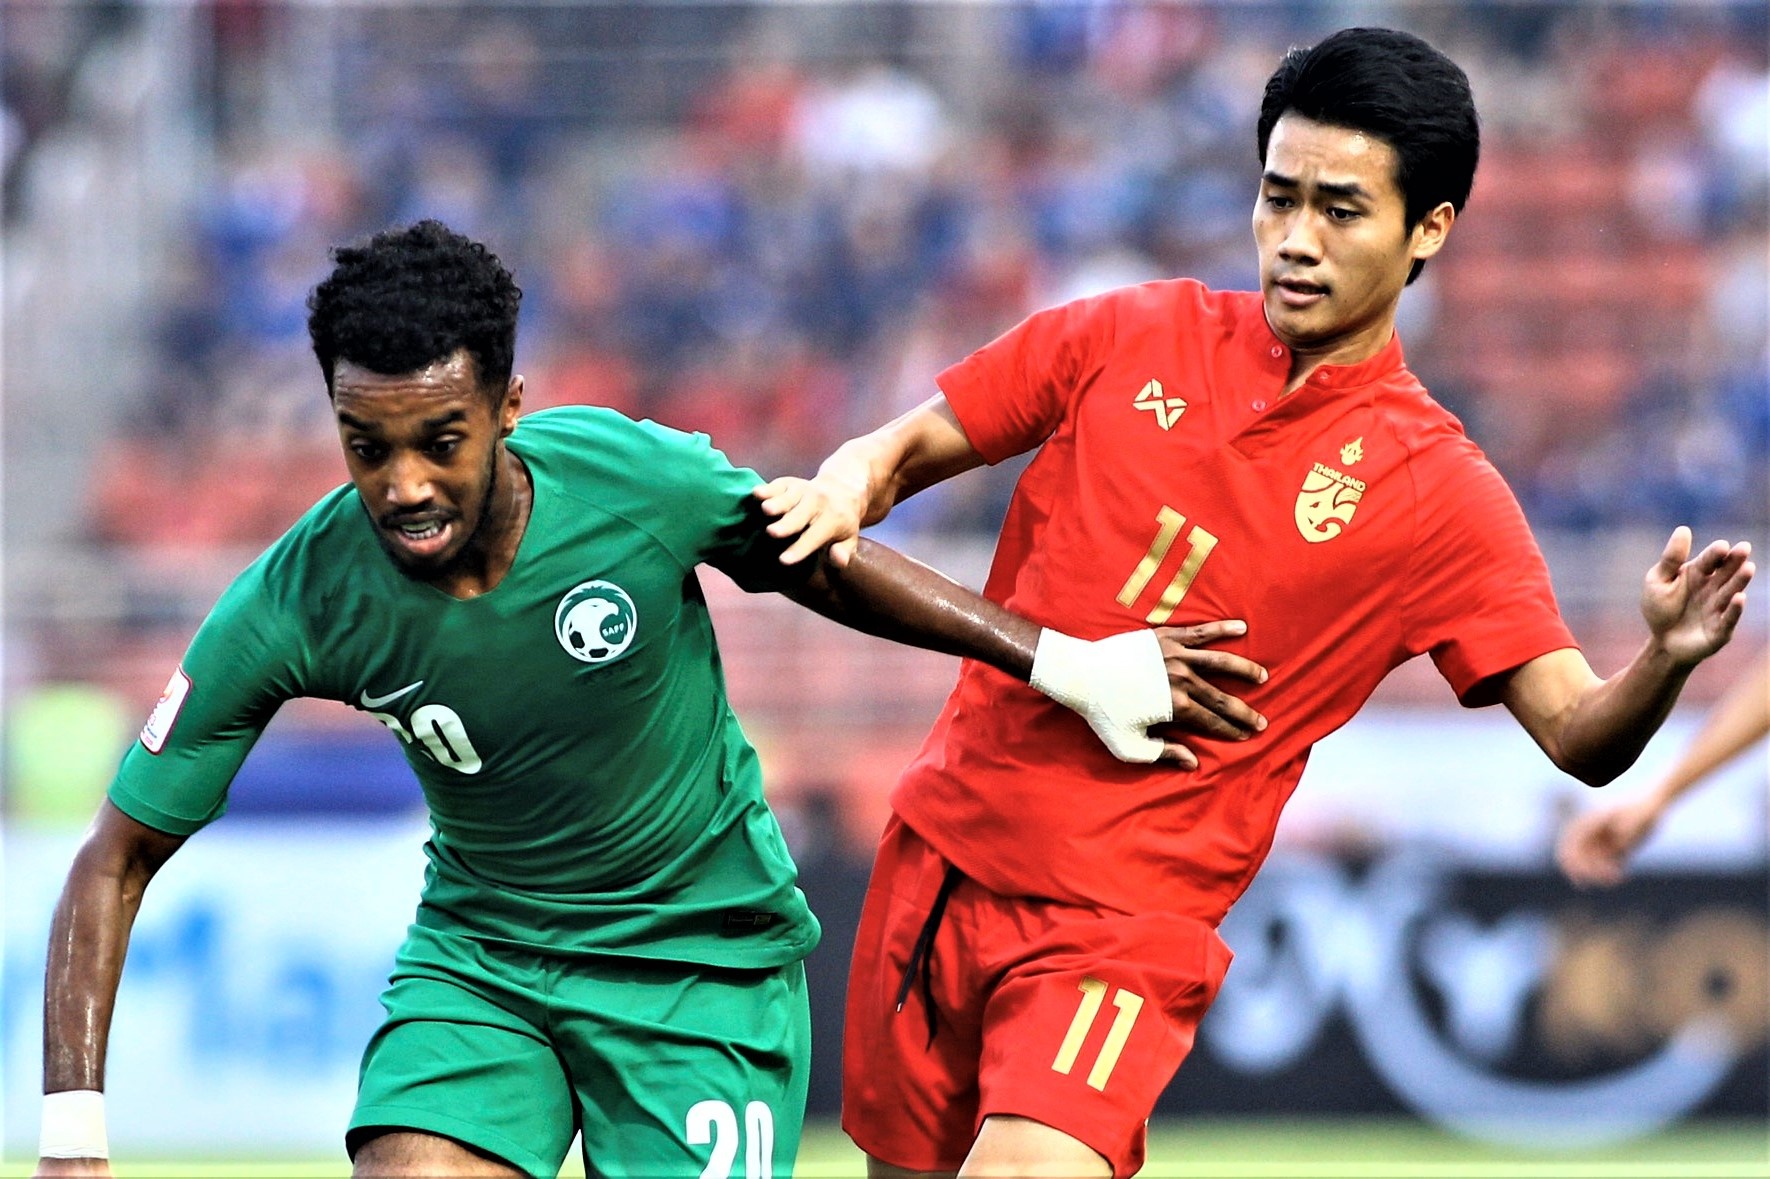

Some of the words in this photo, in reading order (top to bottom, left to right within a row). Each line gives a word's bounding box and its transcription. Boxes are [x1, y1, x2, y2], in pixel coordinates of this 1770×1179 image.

[1115, 504, 1219, 625] 11
[1051, 976, 1144, 1092] 11
[685, 1099, 774, 1179] 20
